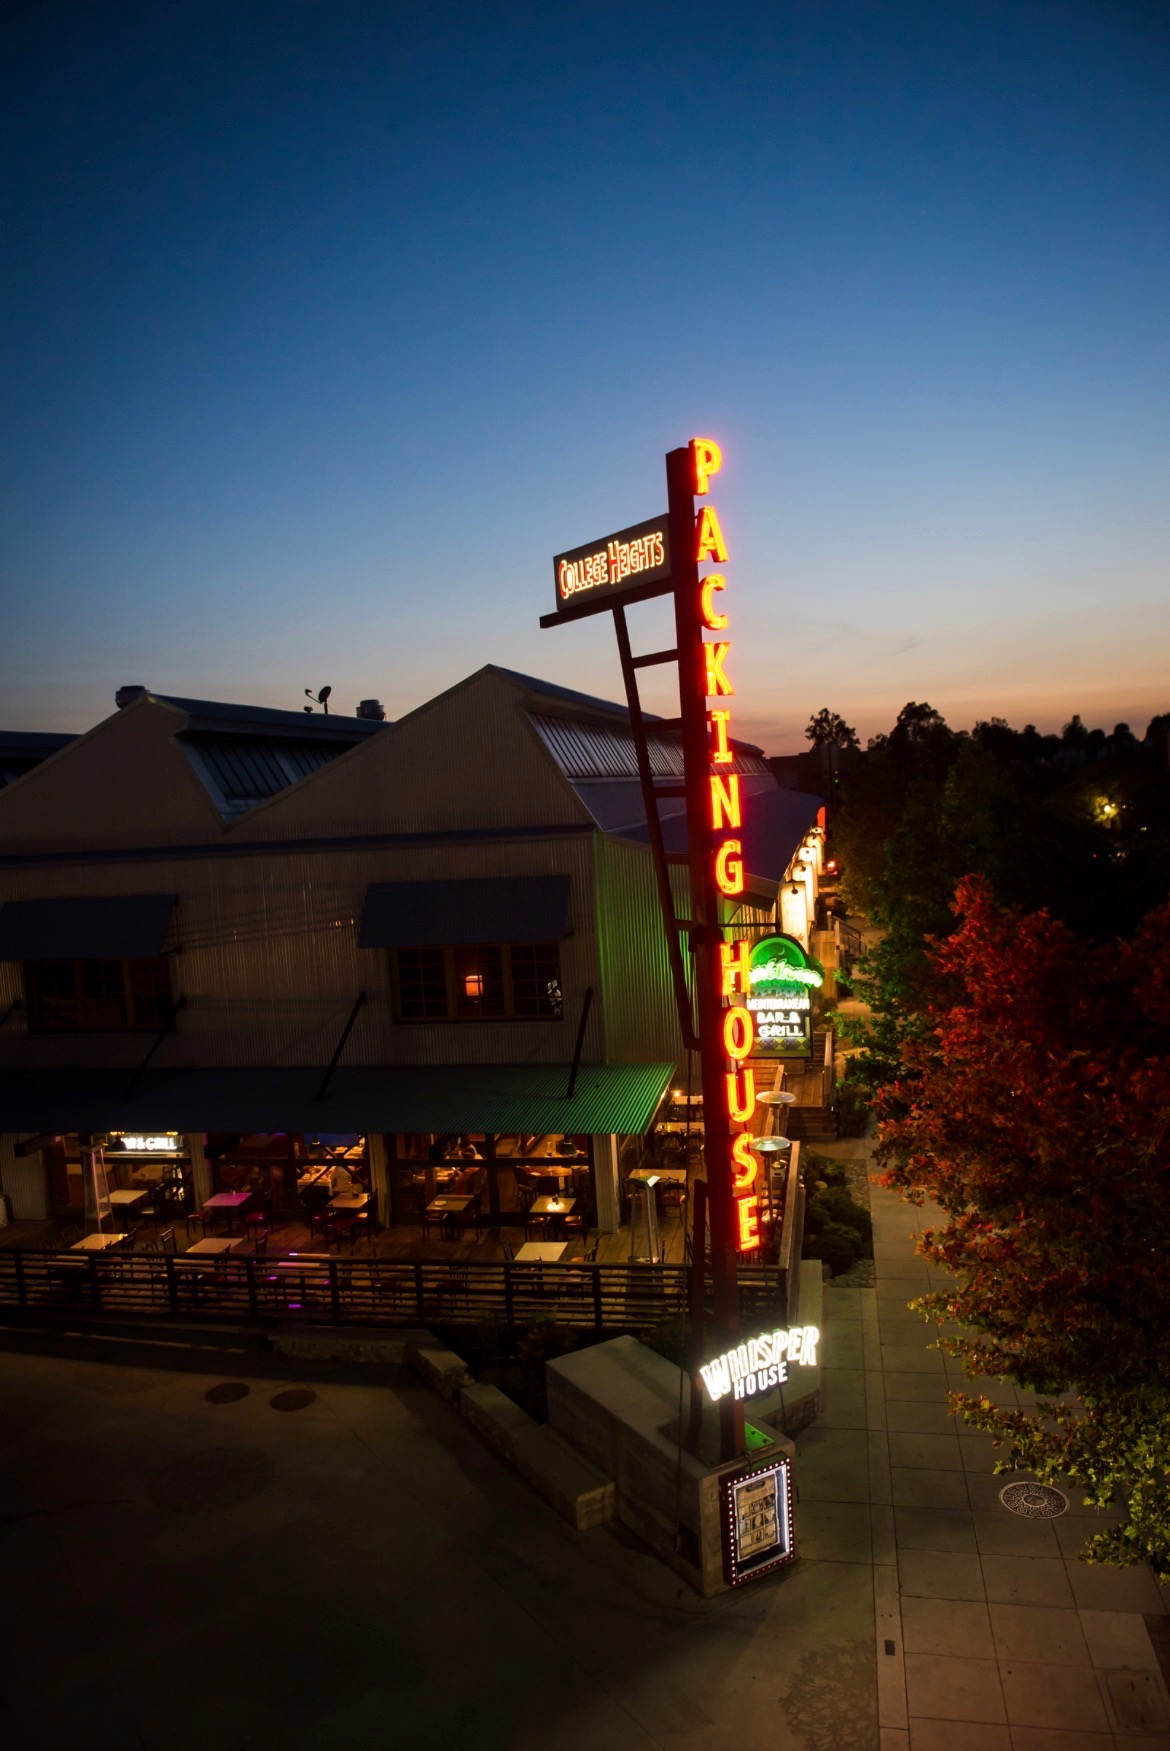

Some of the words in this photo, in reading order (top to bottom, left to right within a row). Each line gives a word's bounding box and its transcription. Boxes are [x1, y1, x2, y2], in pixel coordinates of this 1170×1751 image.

[560, 556, 608, 599] COLLEGE
[607, 532, 664, 584] HEIGHTS
[690, 437, 744, 895] PACKING
[721, 941, 760, 1250] HOUSE
[757, 1012, 783, 1023] BAR
[758, 1025, 803, 1038] GRILL
[699, 1325, 820, 1401] WHISPER
[734, 1361, 788, 1400] HOUSE
